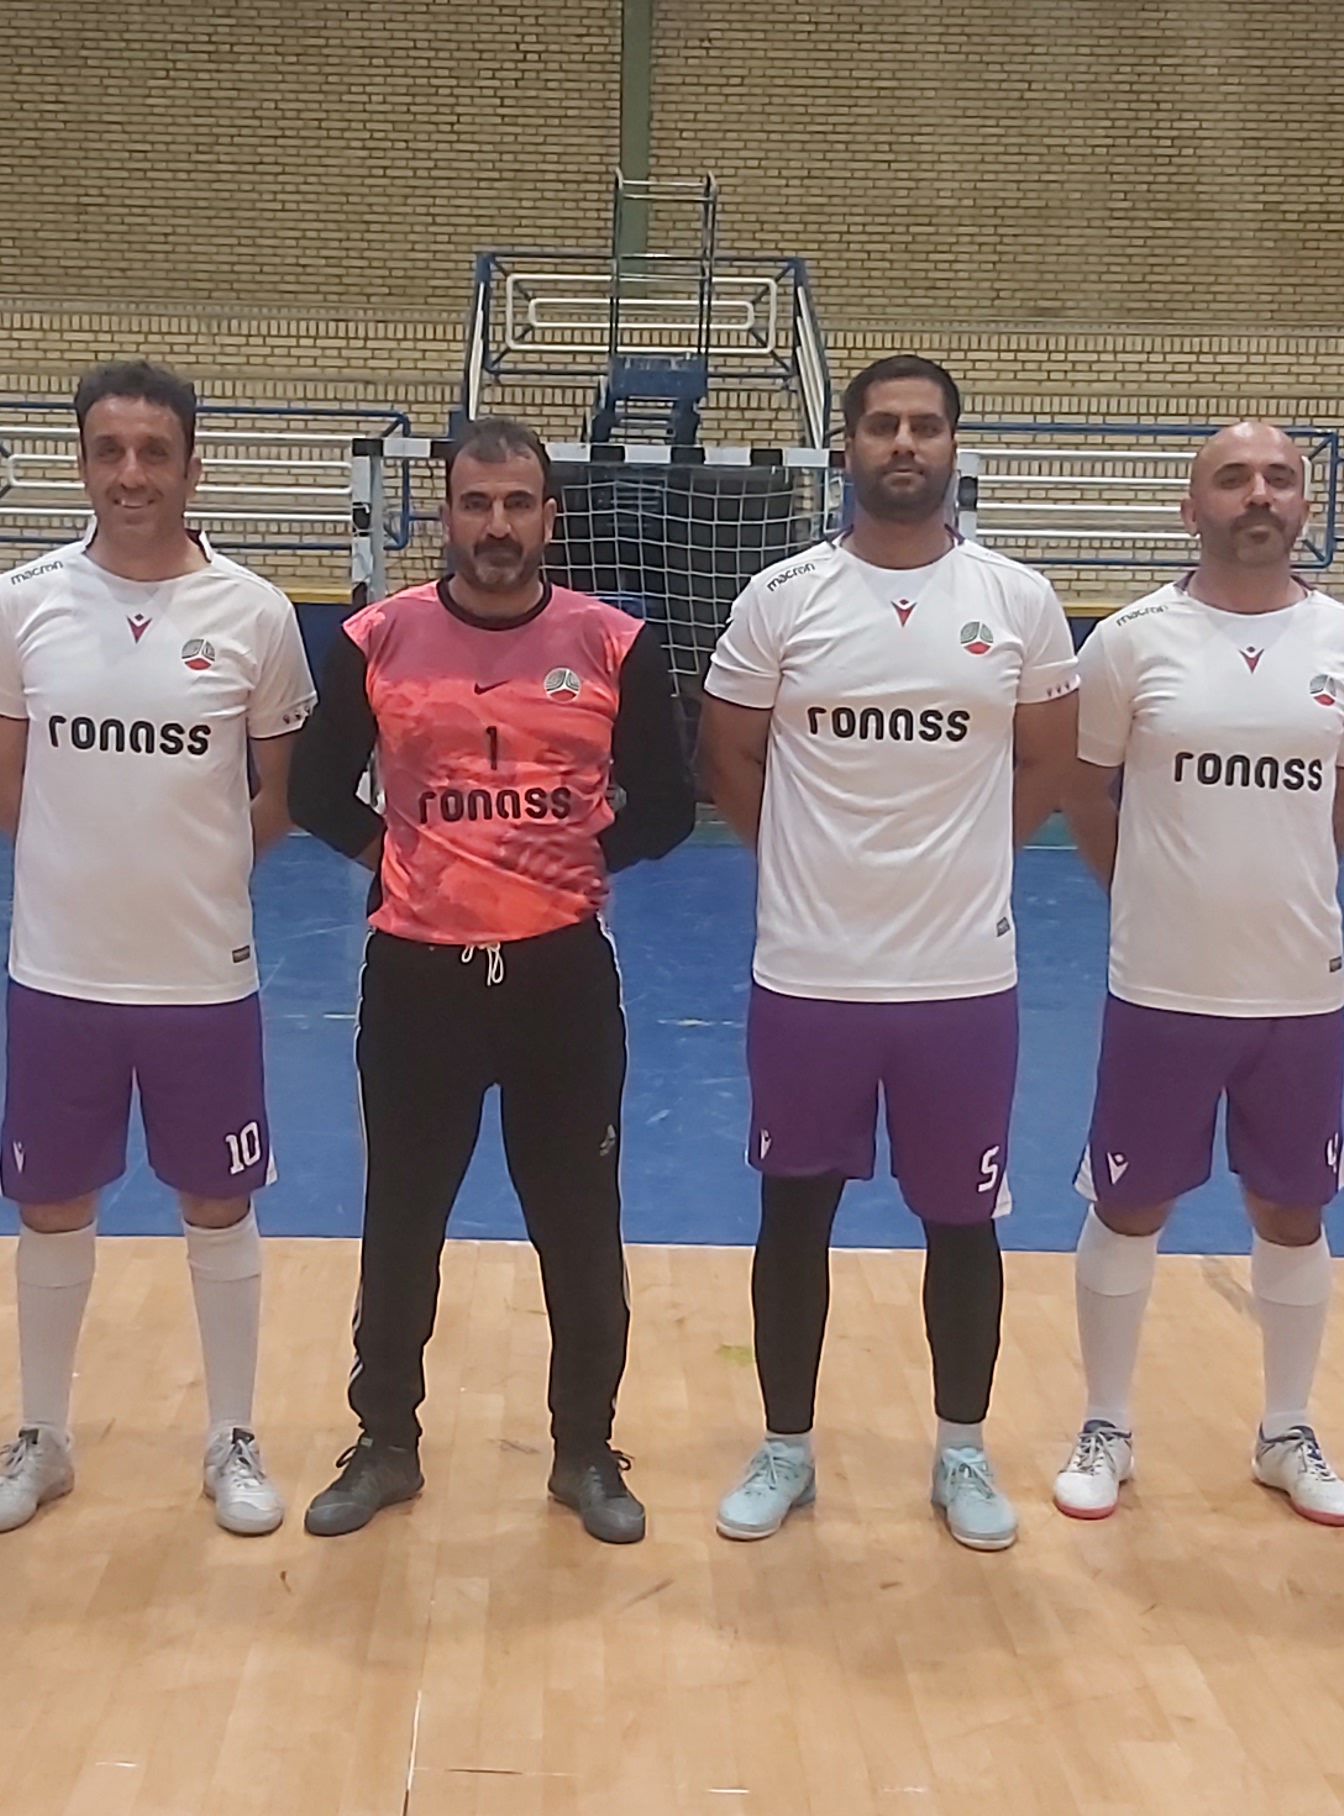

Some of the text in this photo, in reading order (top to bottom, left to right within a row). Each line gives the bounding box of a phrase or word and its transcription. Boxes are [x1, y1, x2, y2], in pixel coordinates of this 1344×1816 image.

[10, 560, 64, 586] macron
[766, 562, 816, 592] macron
[48, 715, 212, 755] ronass
[807, 706, 971, 742] ronass
[485, 725, 498, 771] 1
[1174, 751, 1323, 792] ronass
[418, 786, 572, 825] ronass
[225, 1121, 261, 1175] 10
[977, 1145, 1000, 1193] 5
